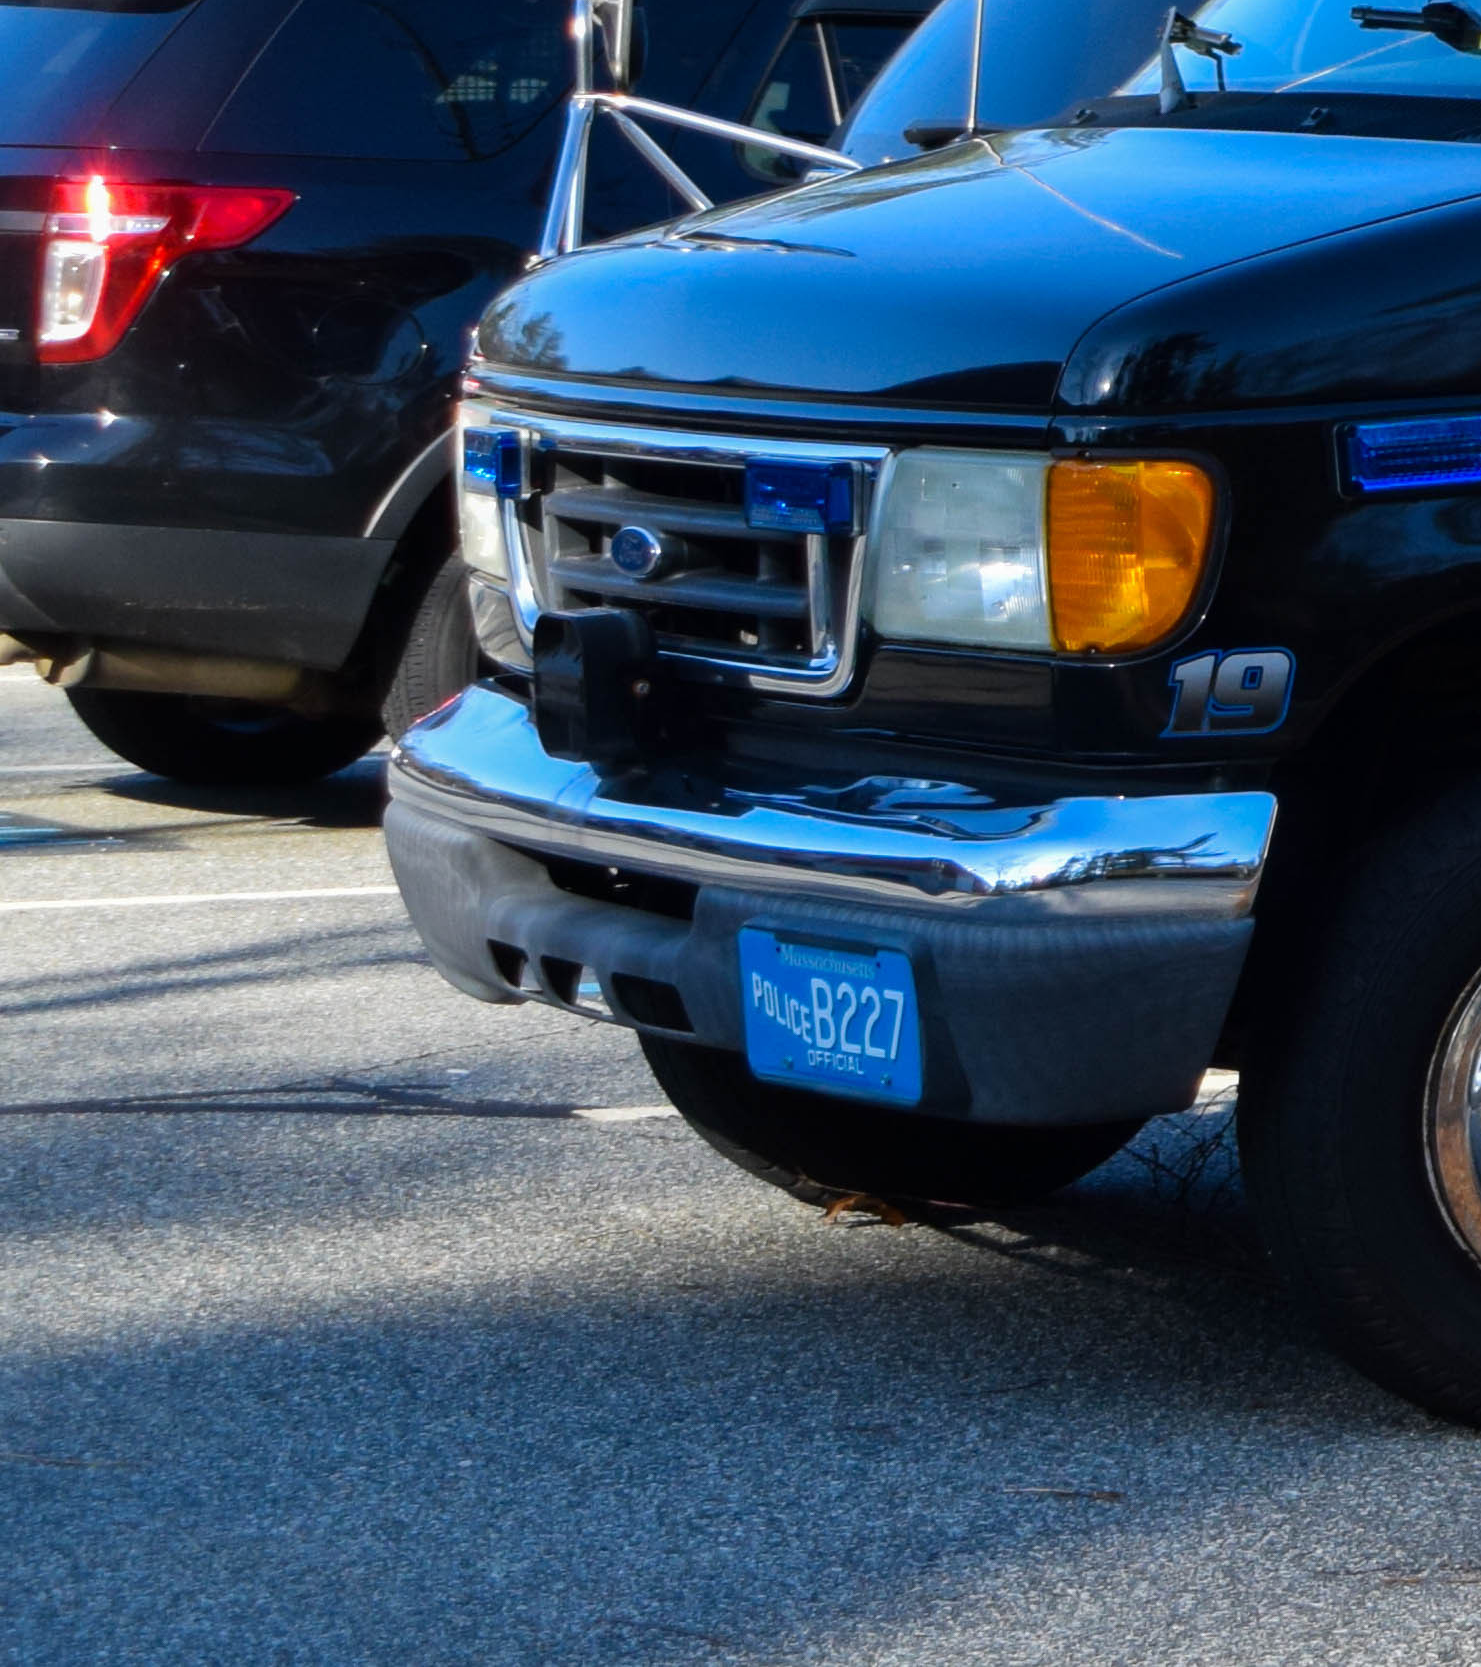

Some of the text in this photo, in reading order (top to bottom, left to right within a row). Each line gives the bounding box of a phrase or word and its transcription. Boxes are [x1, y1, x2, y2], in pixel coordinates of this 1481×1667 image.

[1160, 646, 1296, 739] 19
[752, 971, 904, 1060] POLICE B227
[808, 1049, 864, 1075] OFFICIAL
